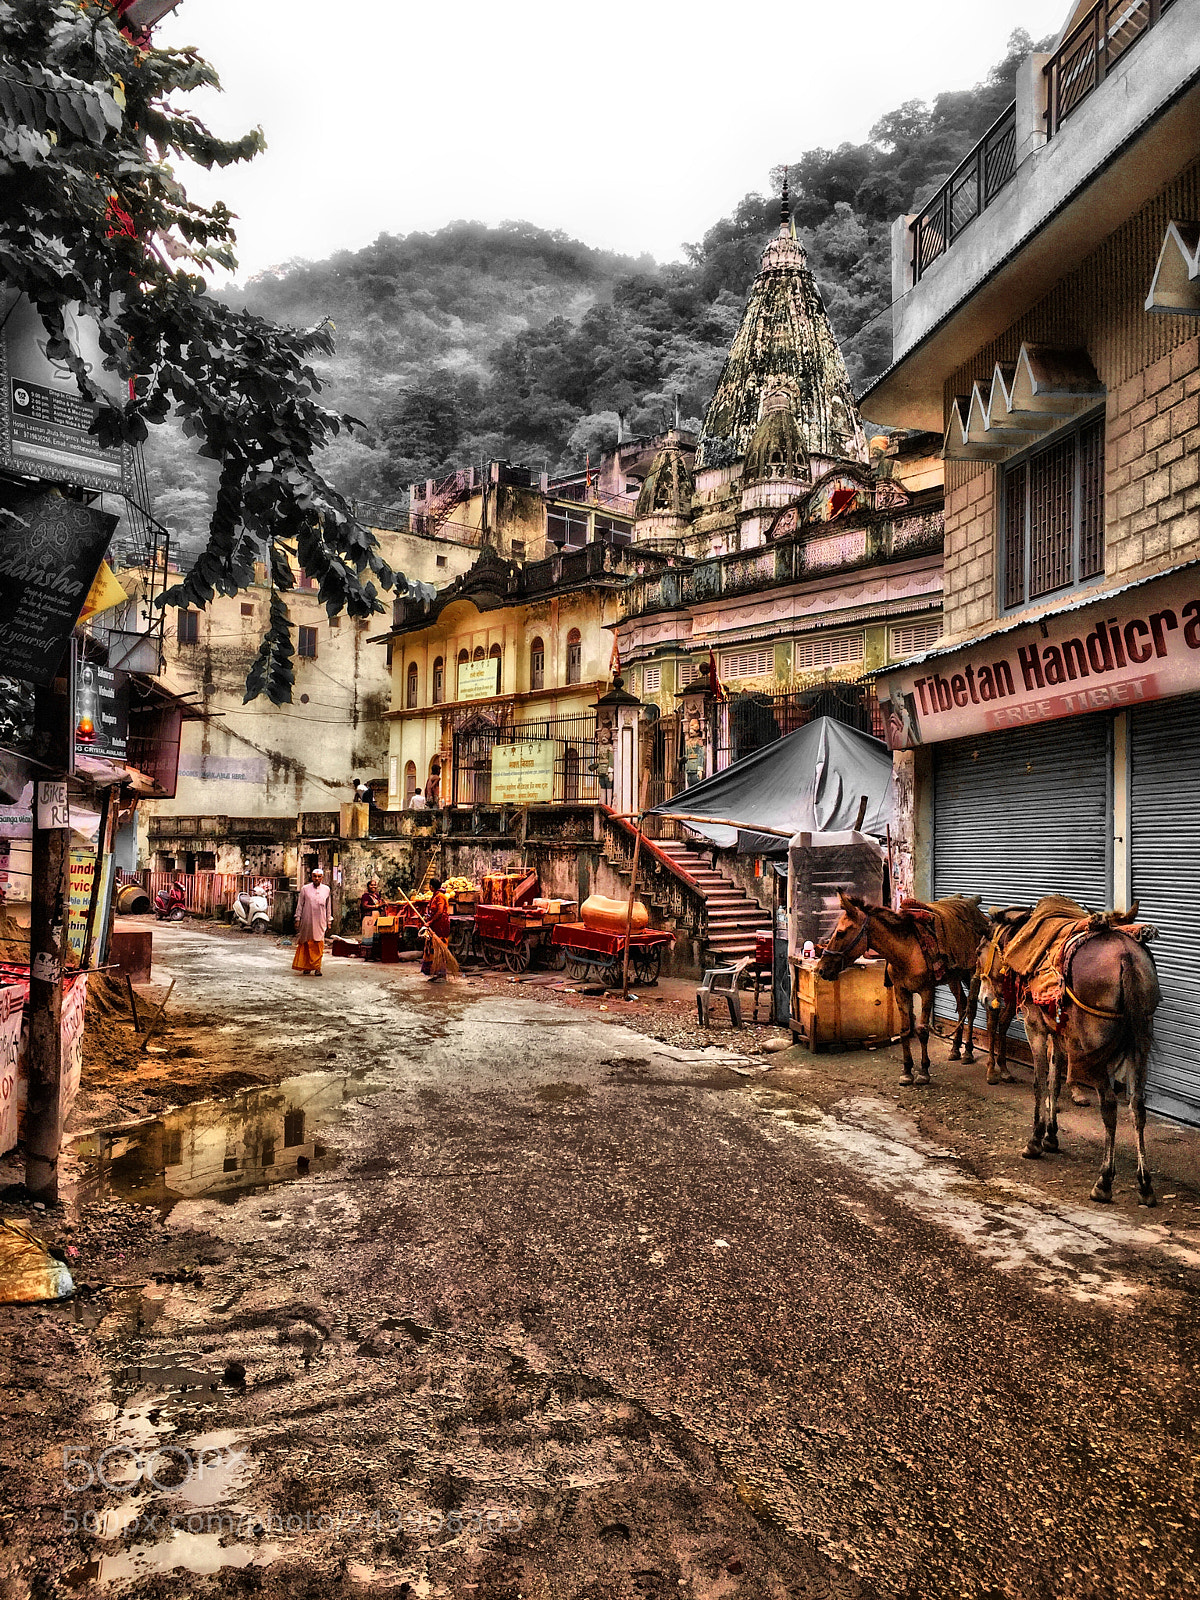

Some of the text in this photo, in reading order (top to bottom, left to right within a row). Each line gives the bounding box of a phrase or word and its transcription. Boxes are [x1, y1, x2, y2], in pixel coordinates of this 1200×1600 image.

[12, 420, 26, 429] Hotel
[2, 629, 59, 653] yourself
[913, 599, 1200, 717] Tibetan Handicra
[993, 678, 1148, 727] FREE TIBET
